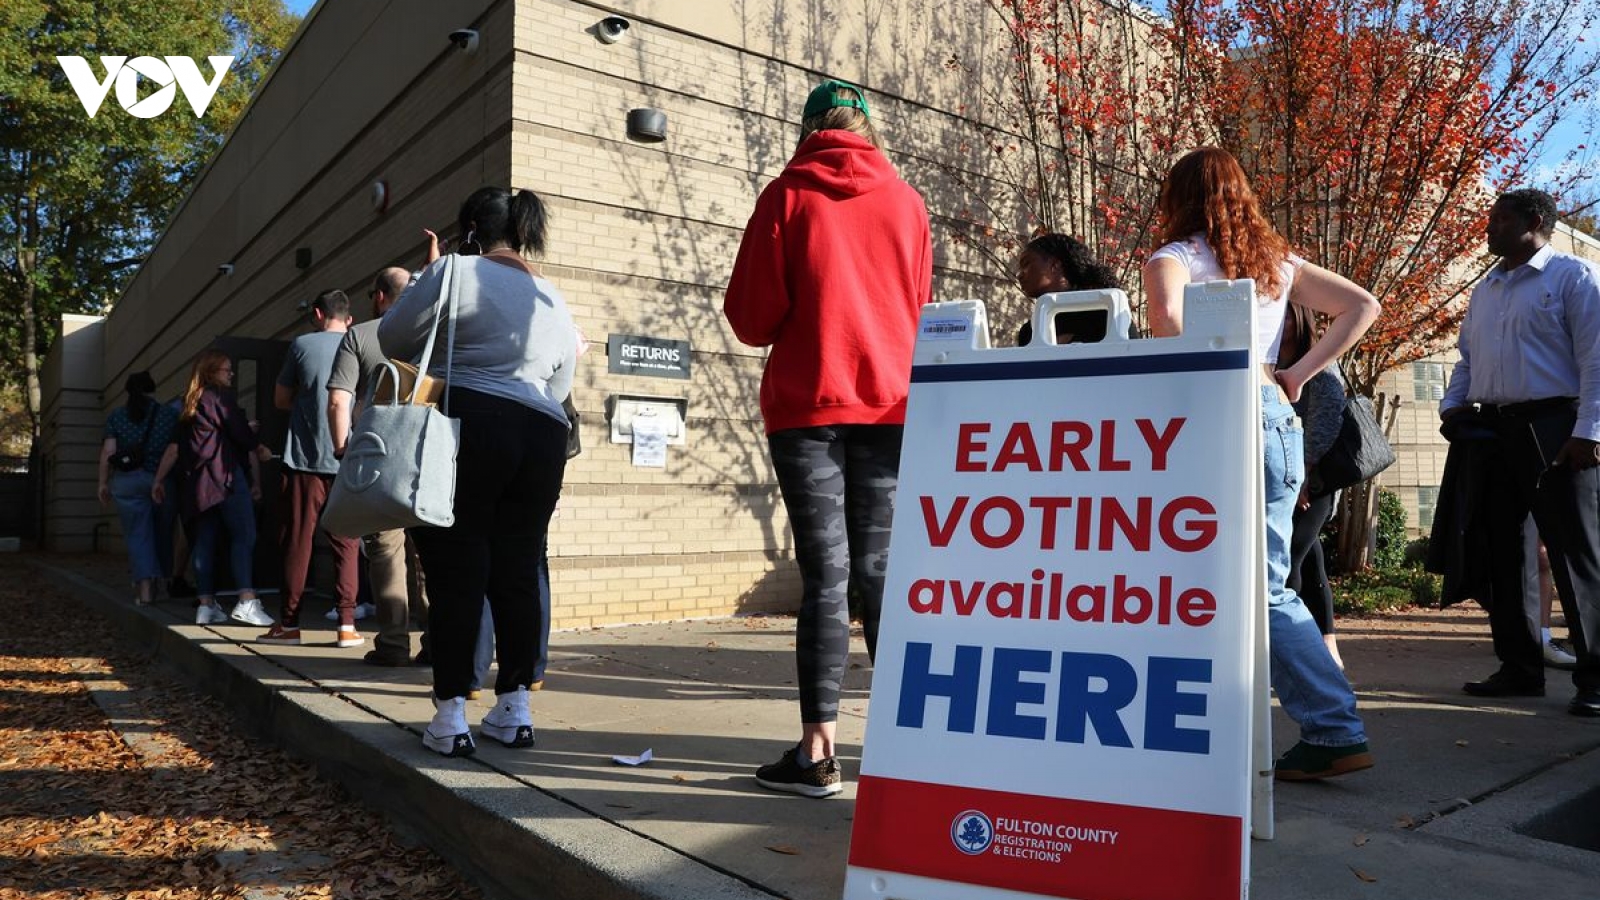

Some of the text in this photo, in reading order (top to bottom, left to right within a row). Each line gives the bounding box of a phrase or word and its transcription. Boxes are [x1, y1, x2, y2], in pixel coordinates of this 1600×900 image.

[620, 344, 681, 362] RETURNS
[955, 417, 1187, 473] EARLY
[919, 495, 1219, 553] VOTING
[907, 568, 1218, 627] available
[896, 641, 1214, 755] HERE
[994, 834, 1072, 853] REGISTRATION
[995, 817, 1119, 845] FULTON COUNTY
[992, 846, 1061, 863] & ELECTIONS
